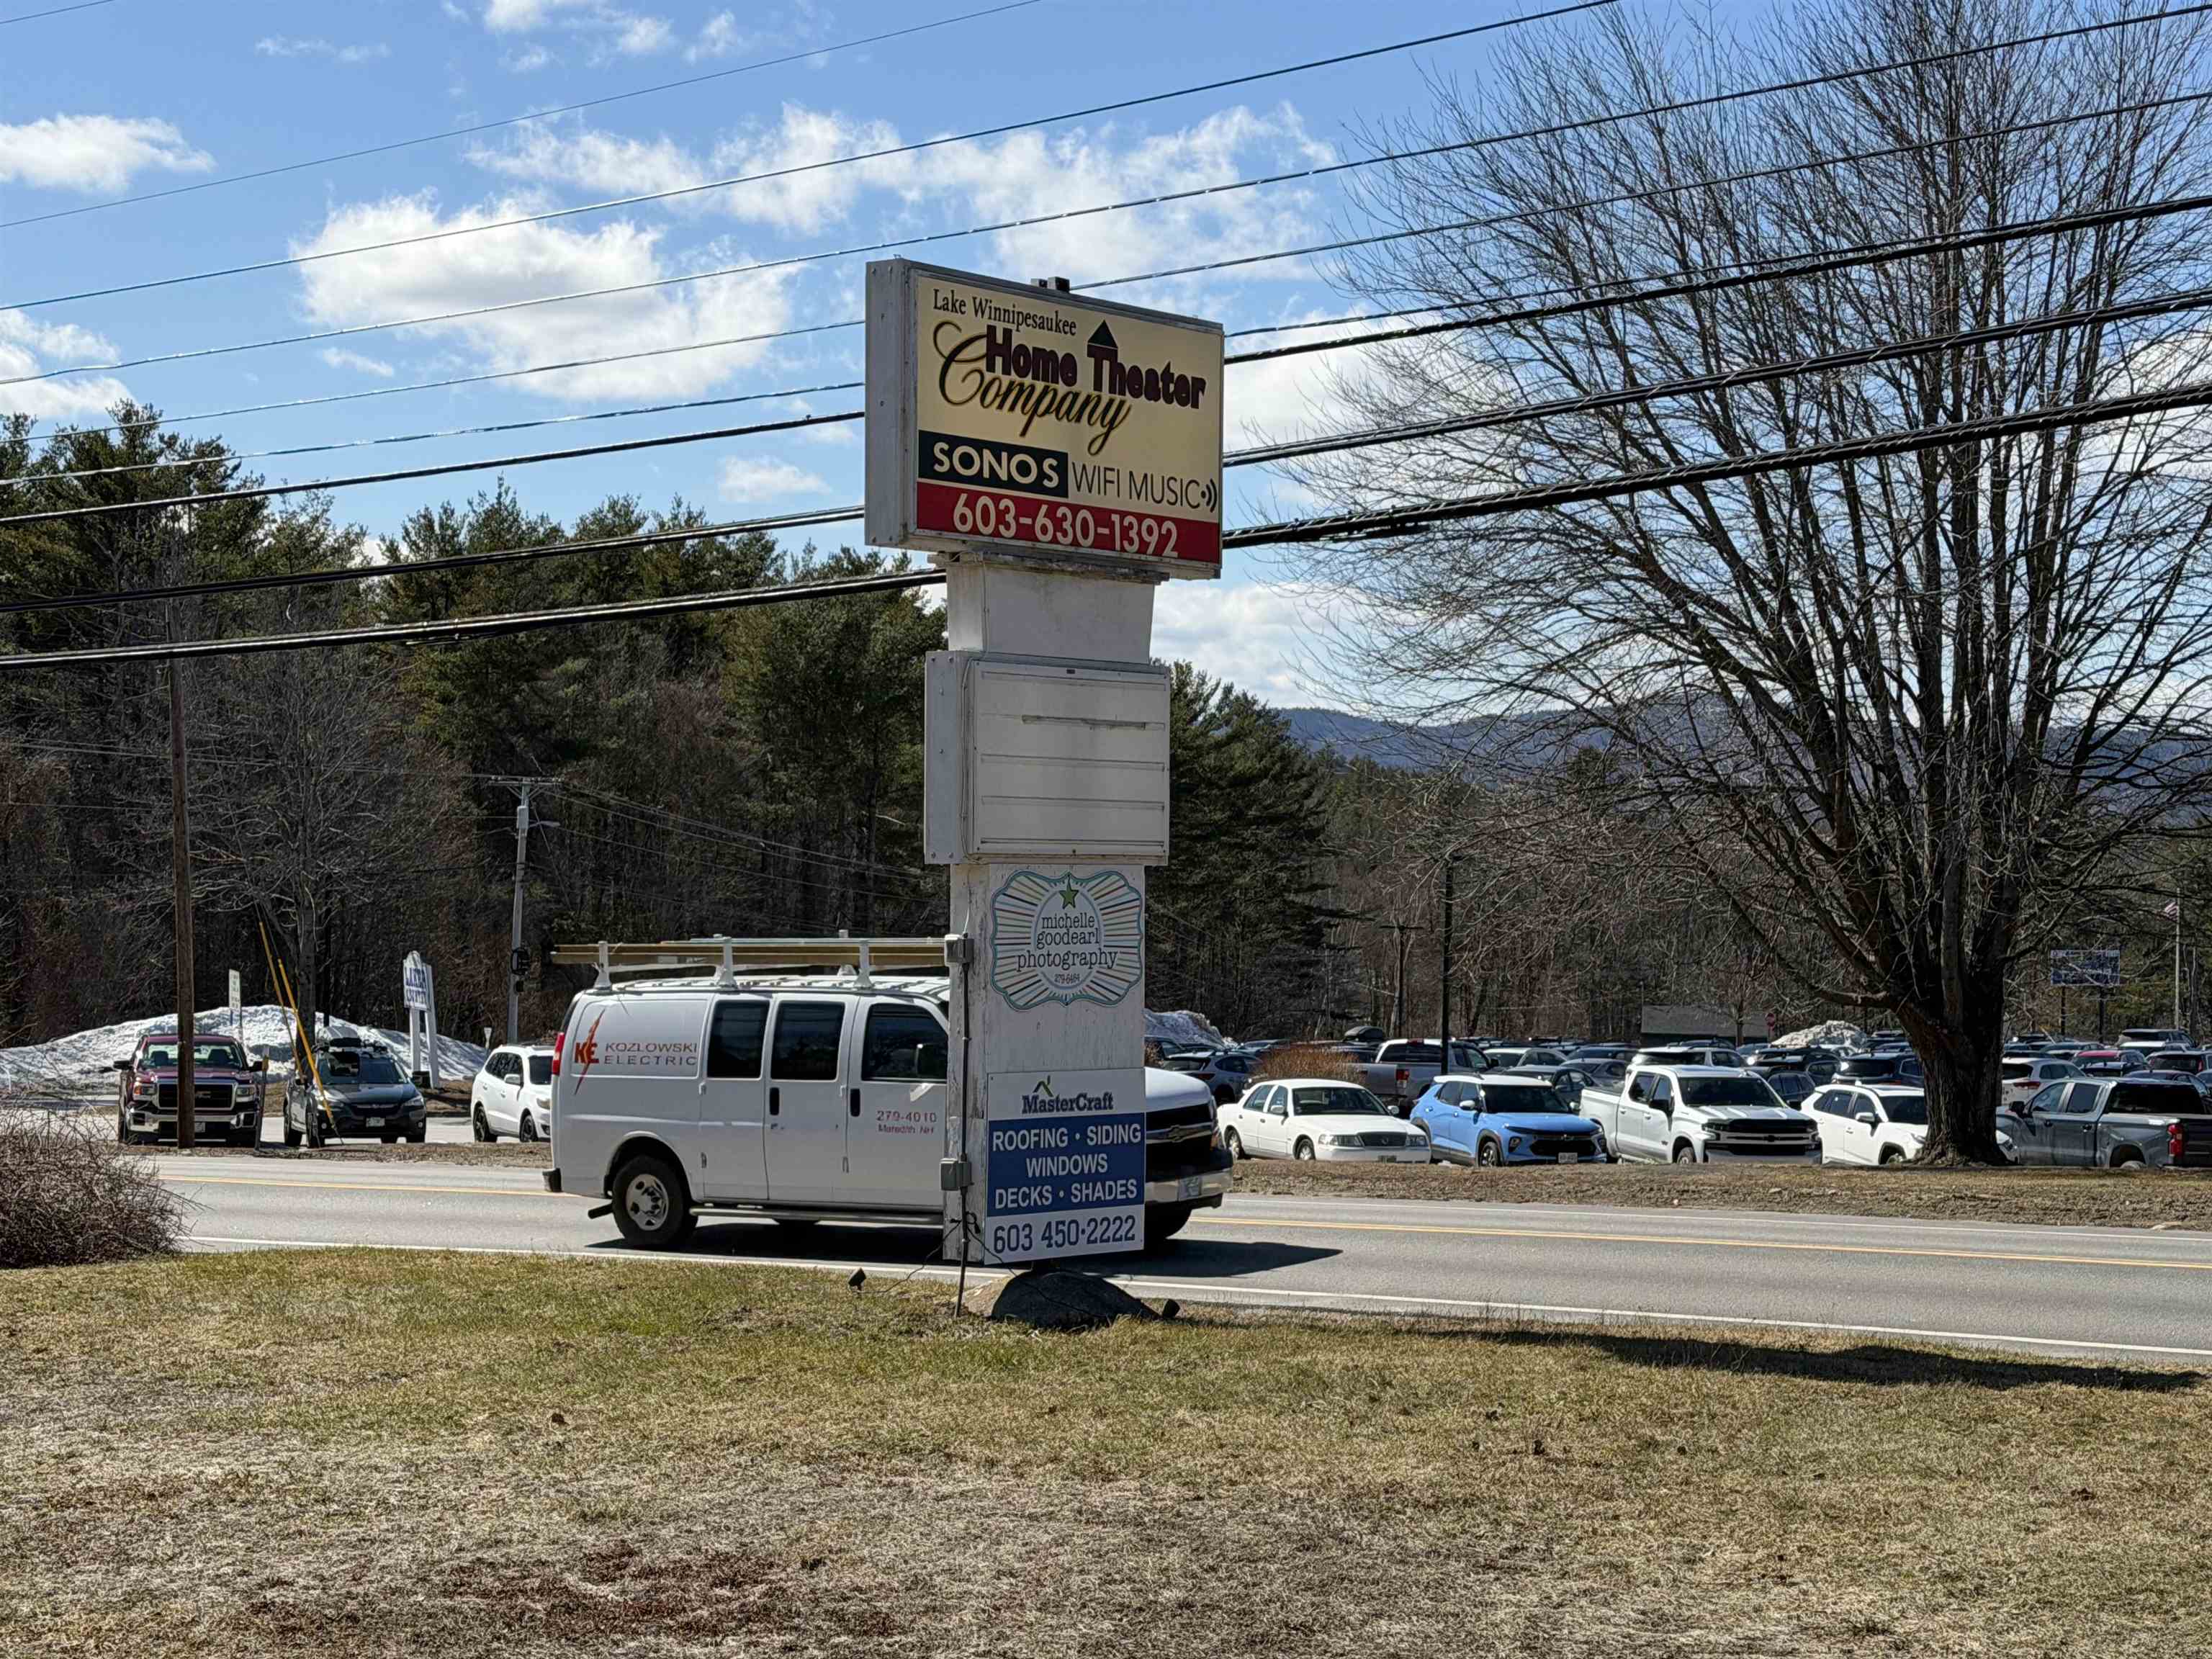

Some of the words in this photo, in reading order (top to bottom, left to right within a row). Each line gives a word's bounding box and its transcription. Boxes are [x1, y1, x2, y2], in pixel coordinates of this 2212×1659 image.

[933, 288, 966, 315] Lake
[972, 296, 1076, 336] Winnipesaukee
[986, 324, 1077, 387] Home
[1087, 343, 1207, 410] Theater
[933, 321, 1132, 457] Company
[933, 441, 1059, 488] SONOS
[1071, 462, 1120, 498] WIFI
[1128, 470, 1200, 509] MUSIC
[953, 493, 1179, 558] 603-630-1392
[1041, 912, 1095, 929] michelle
[1036, 927, 1100, 950] goodearl
[1016, 947, 1118, 972] photography
[604, 1055, 698, 1066] ELECTRIC
[605, 1043, 697, 1053] KOZLOWSKI
[876, 1110, 938, 1123] 279-4010
[1021, 1092, 1114, 1115] MasterCraft
[992, 1127, 1069, 1151] ROOFING
[1086, 1123, 1141, 1146] SIDING
[1026, 1154, 1108, 1177] WINDOWS
[994, 1185, 1053, 1209] DECKS
[1071, 1179, 1138, 1203] SHADES
[993, 1223, 1033, 1254] 603
